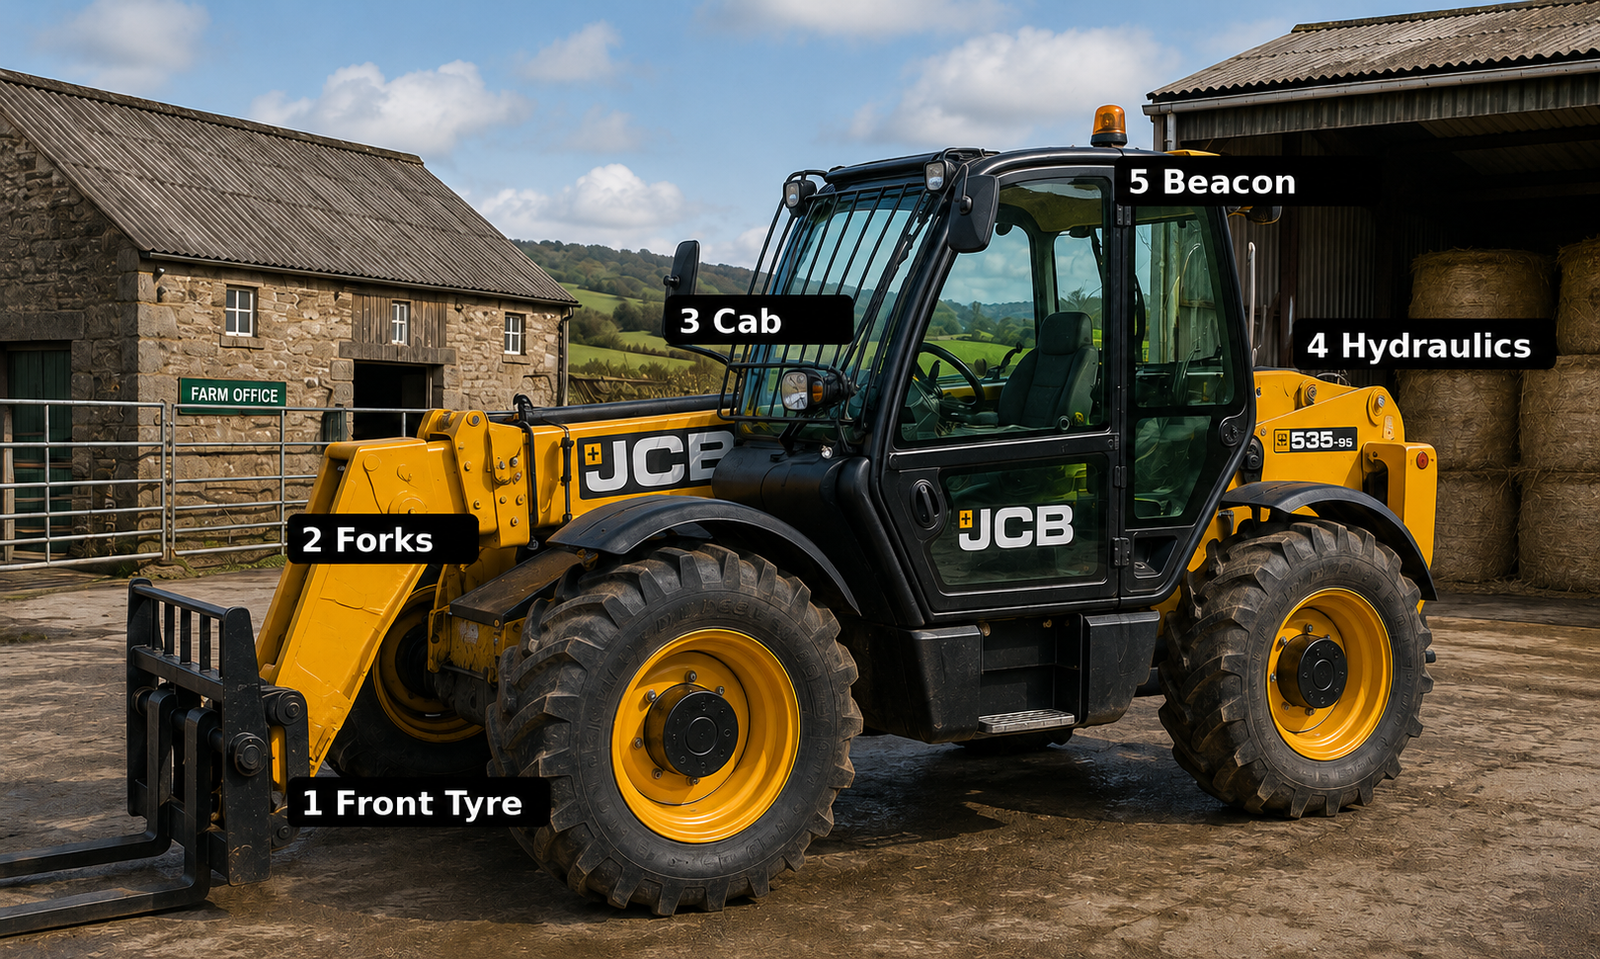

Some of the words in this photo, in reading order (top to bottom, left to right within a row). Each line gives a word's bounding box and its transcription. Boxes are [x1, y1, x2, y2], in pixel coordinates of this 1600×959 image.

[191, 387, 229, 401] FARM
[233, 388, 278, 403] OFFICE
[1291, 431, 1353, 449] 535-95
[585, 430, 735, 493] JCB
[958, 504, 1074, 551] JCB
